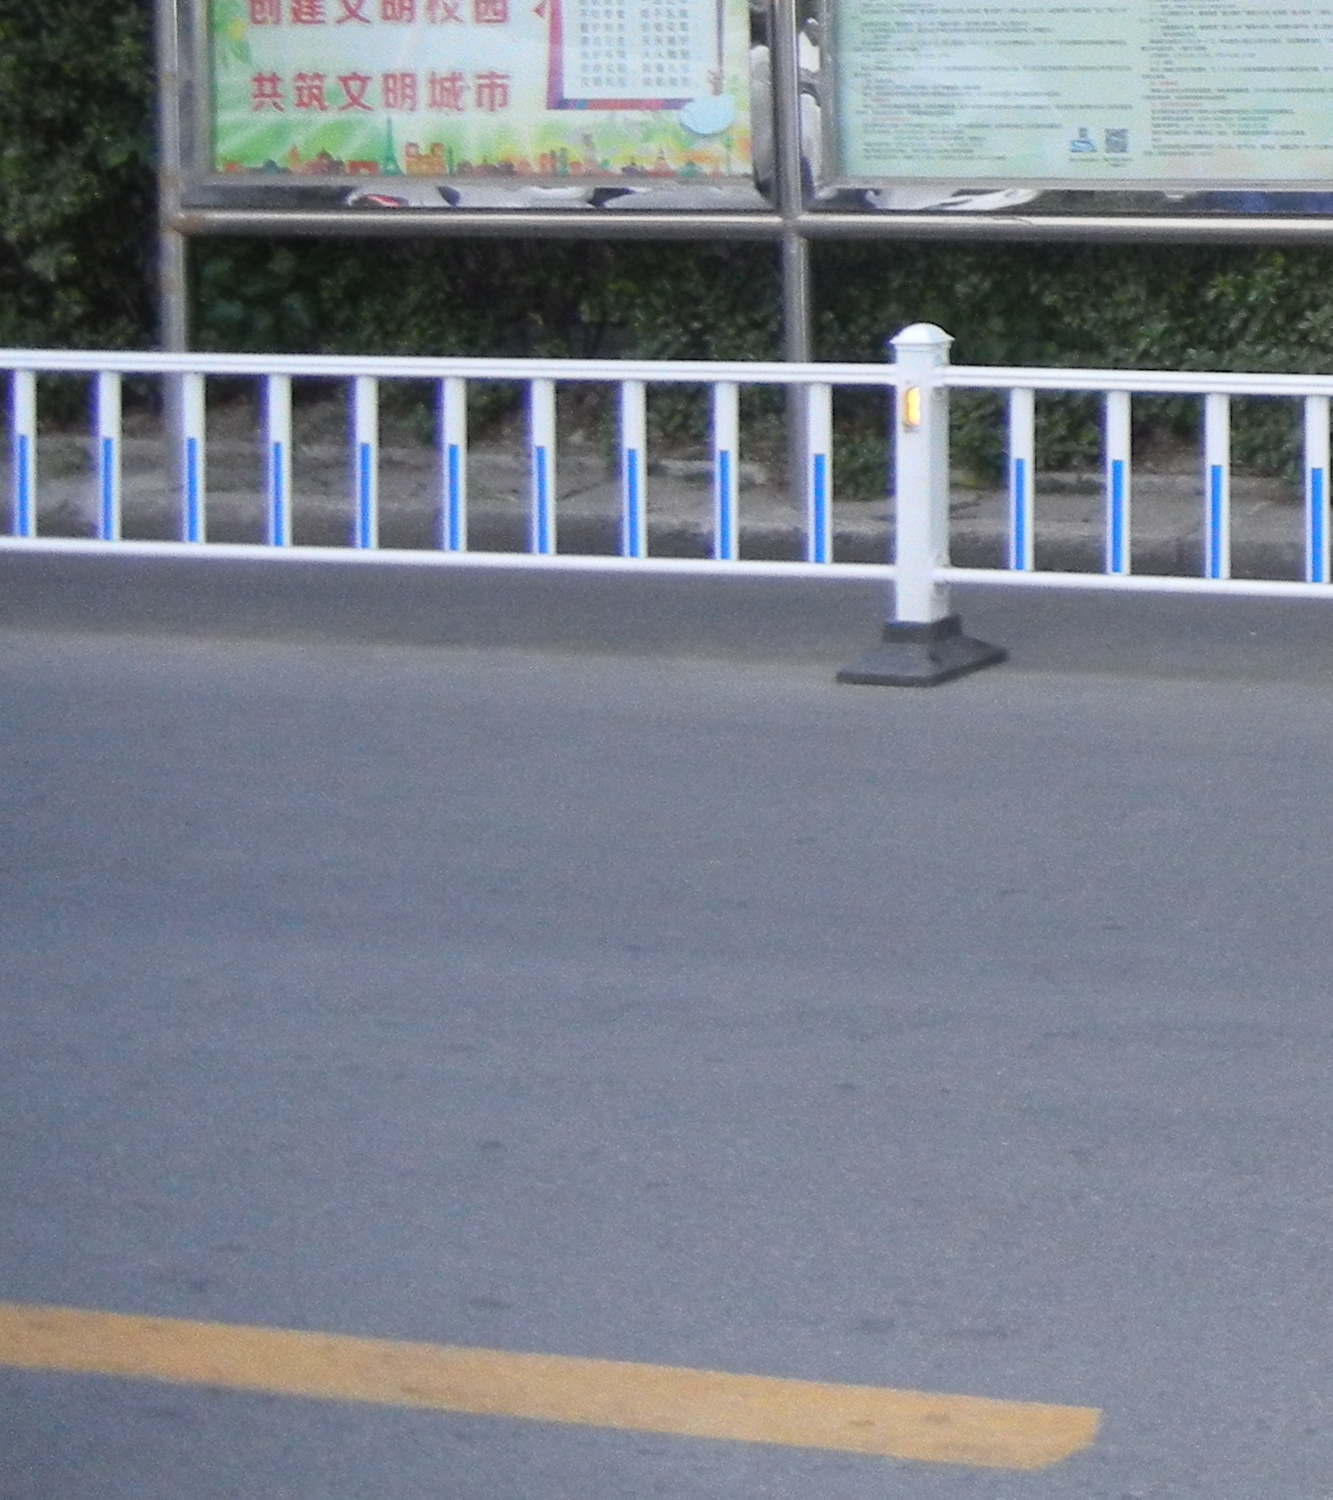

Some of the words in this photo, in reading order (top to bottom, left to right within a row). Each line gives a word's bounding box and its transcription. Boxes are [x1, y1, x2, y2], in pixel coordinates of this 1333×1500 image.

[251, 71, 512, 115] 共筑文明城市
